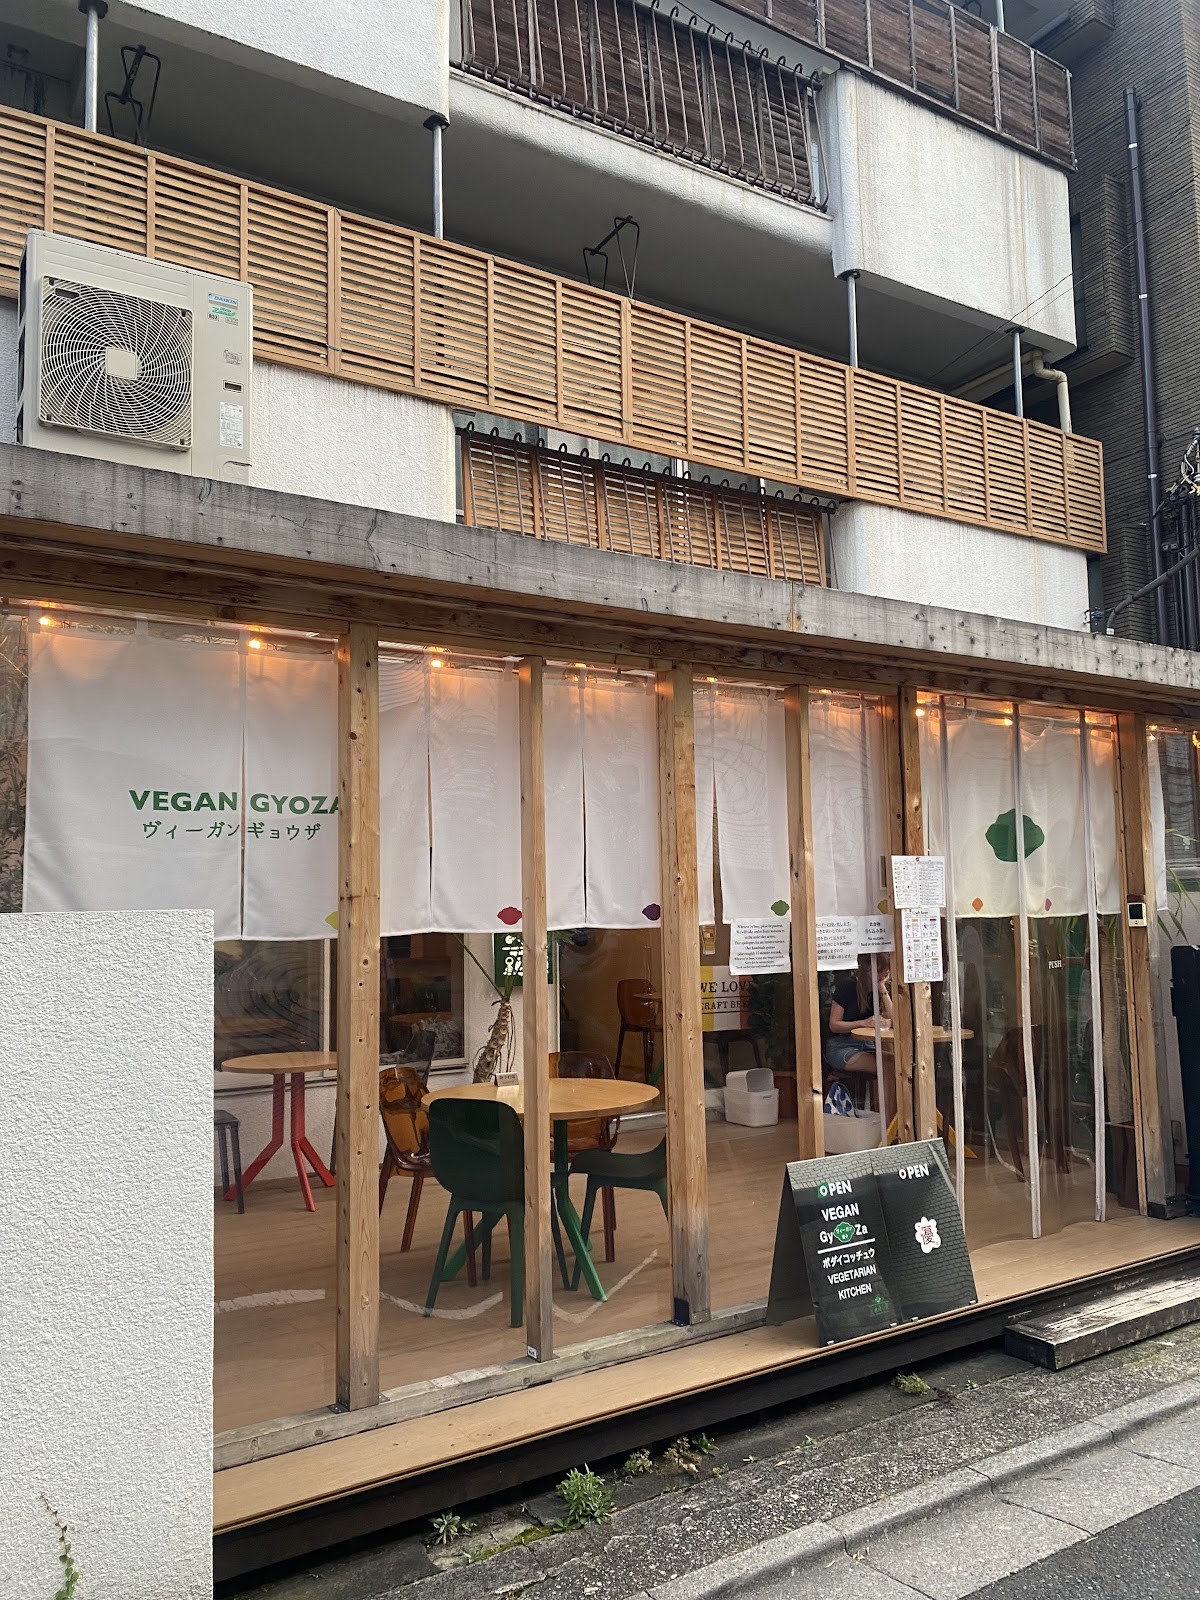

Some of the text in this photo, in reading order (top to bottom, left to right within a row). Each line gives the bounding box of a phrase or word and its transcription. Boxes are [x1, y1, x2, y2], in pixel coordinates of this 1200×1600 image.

[129, 790, 237, 811] VEGAN
[1048, 960, 1062, 969] PUSH
[722, 981, 751, 992] LOV
[899, 1163, 929, 1180] OPEN
[820, 1180, 852, 1196] OPEN
[821, 1203, 859, 1221] VEGAN
[827, 1264, 877, 1285] VEGETARIAN
[838, 1282, 872, 1300] KITCHEN
